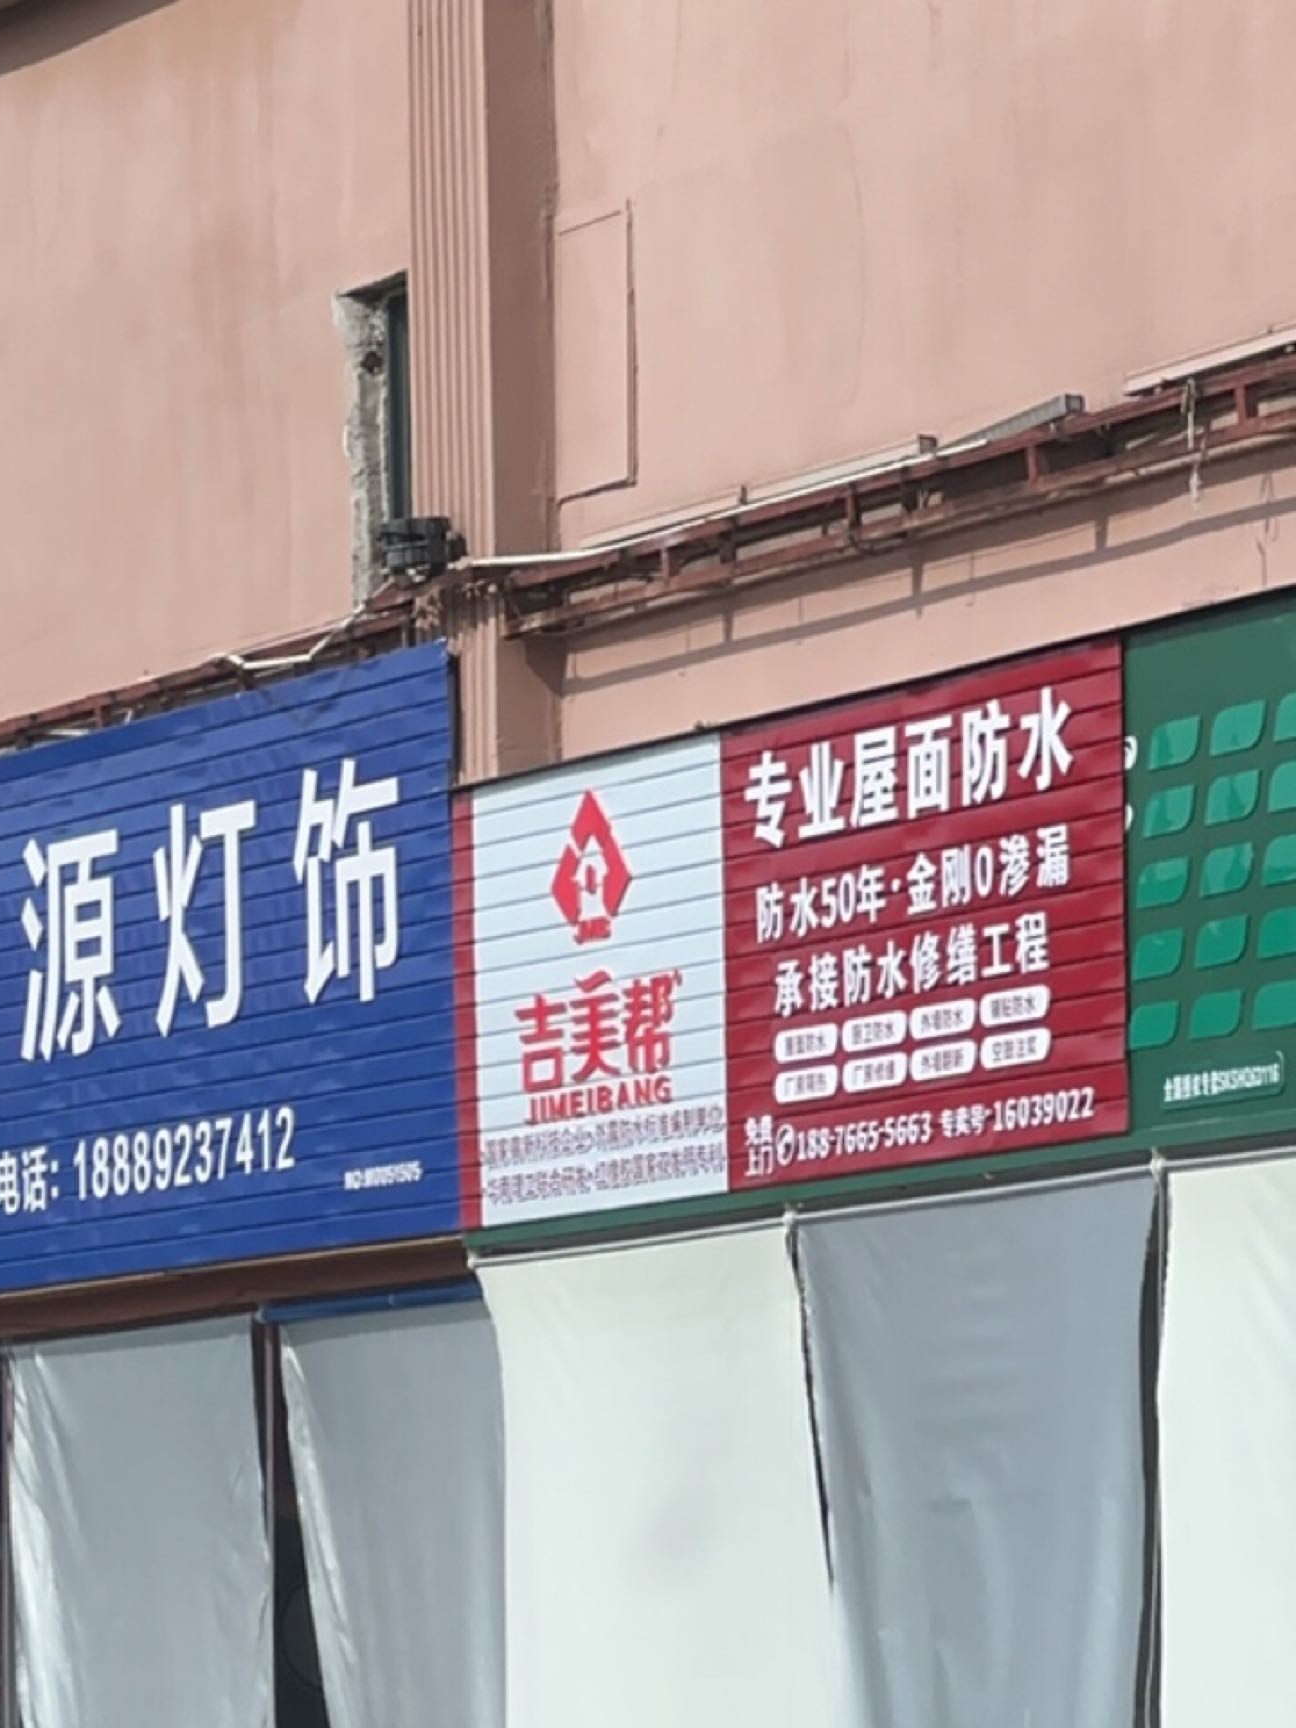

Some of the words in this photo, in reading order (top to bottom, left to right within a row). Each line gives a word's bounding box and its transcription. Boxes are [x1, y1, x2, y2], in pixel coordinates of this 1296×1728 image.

[744, 686, 1073, 848] 专业屋面防水
[775, 911, 1049, 1017] 承接防水修缮工程
[514, 967, 676, 1093] 吉美帮
[524, 1078, 672, 1126] JIMEIBANG
[797, 1111, 933, 1161] 188-7665-5663
